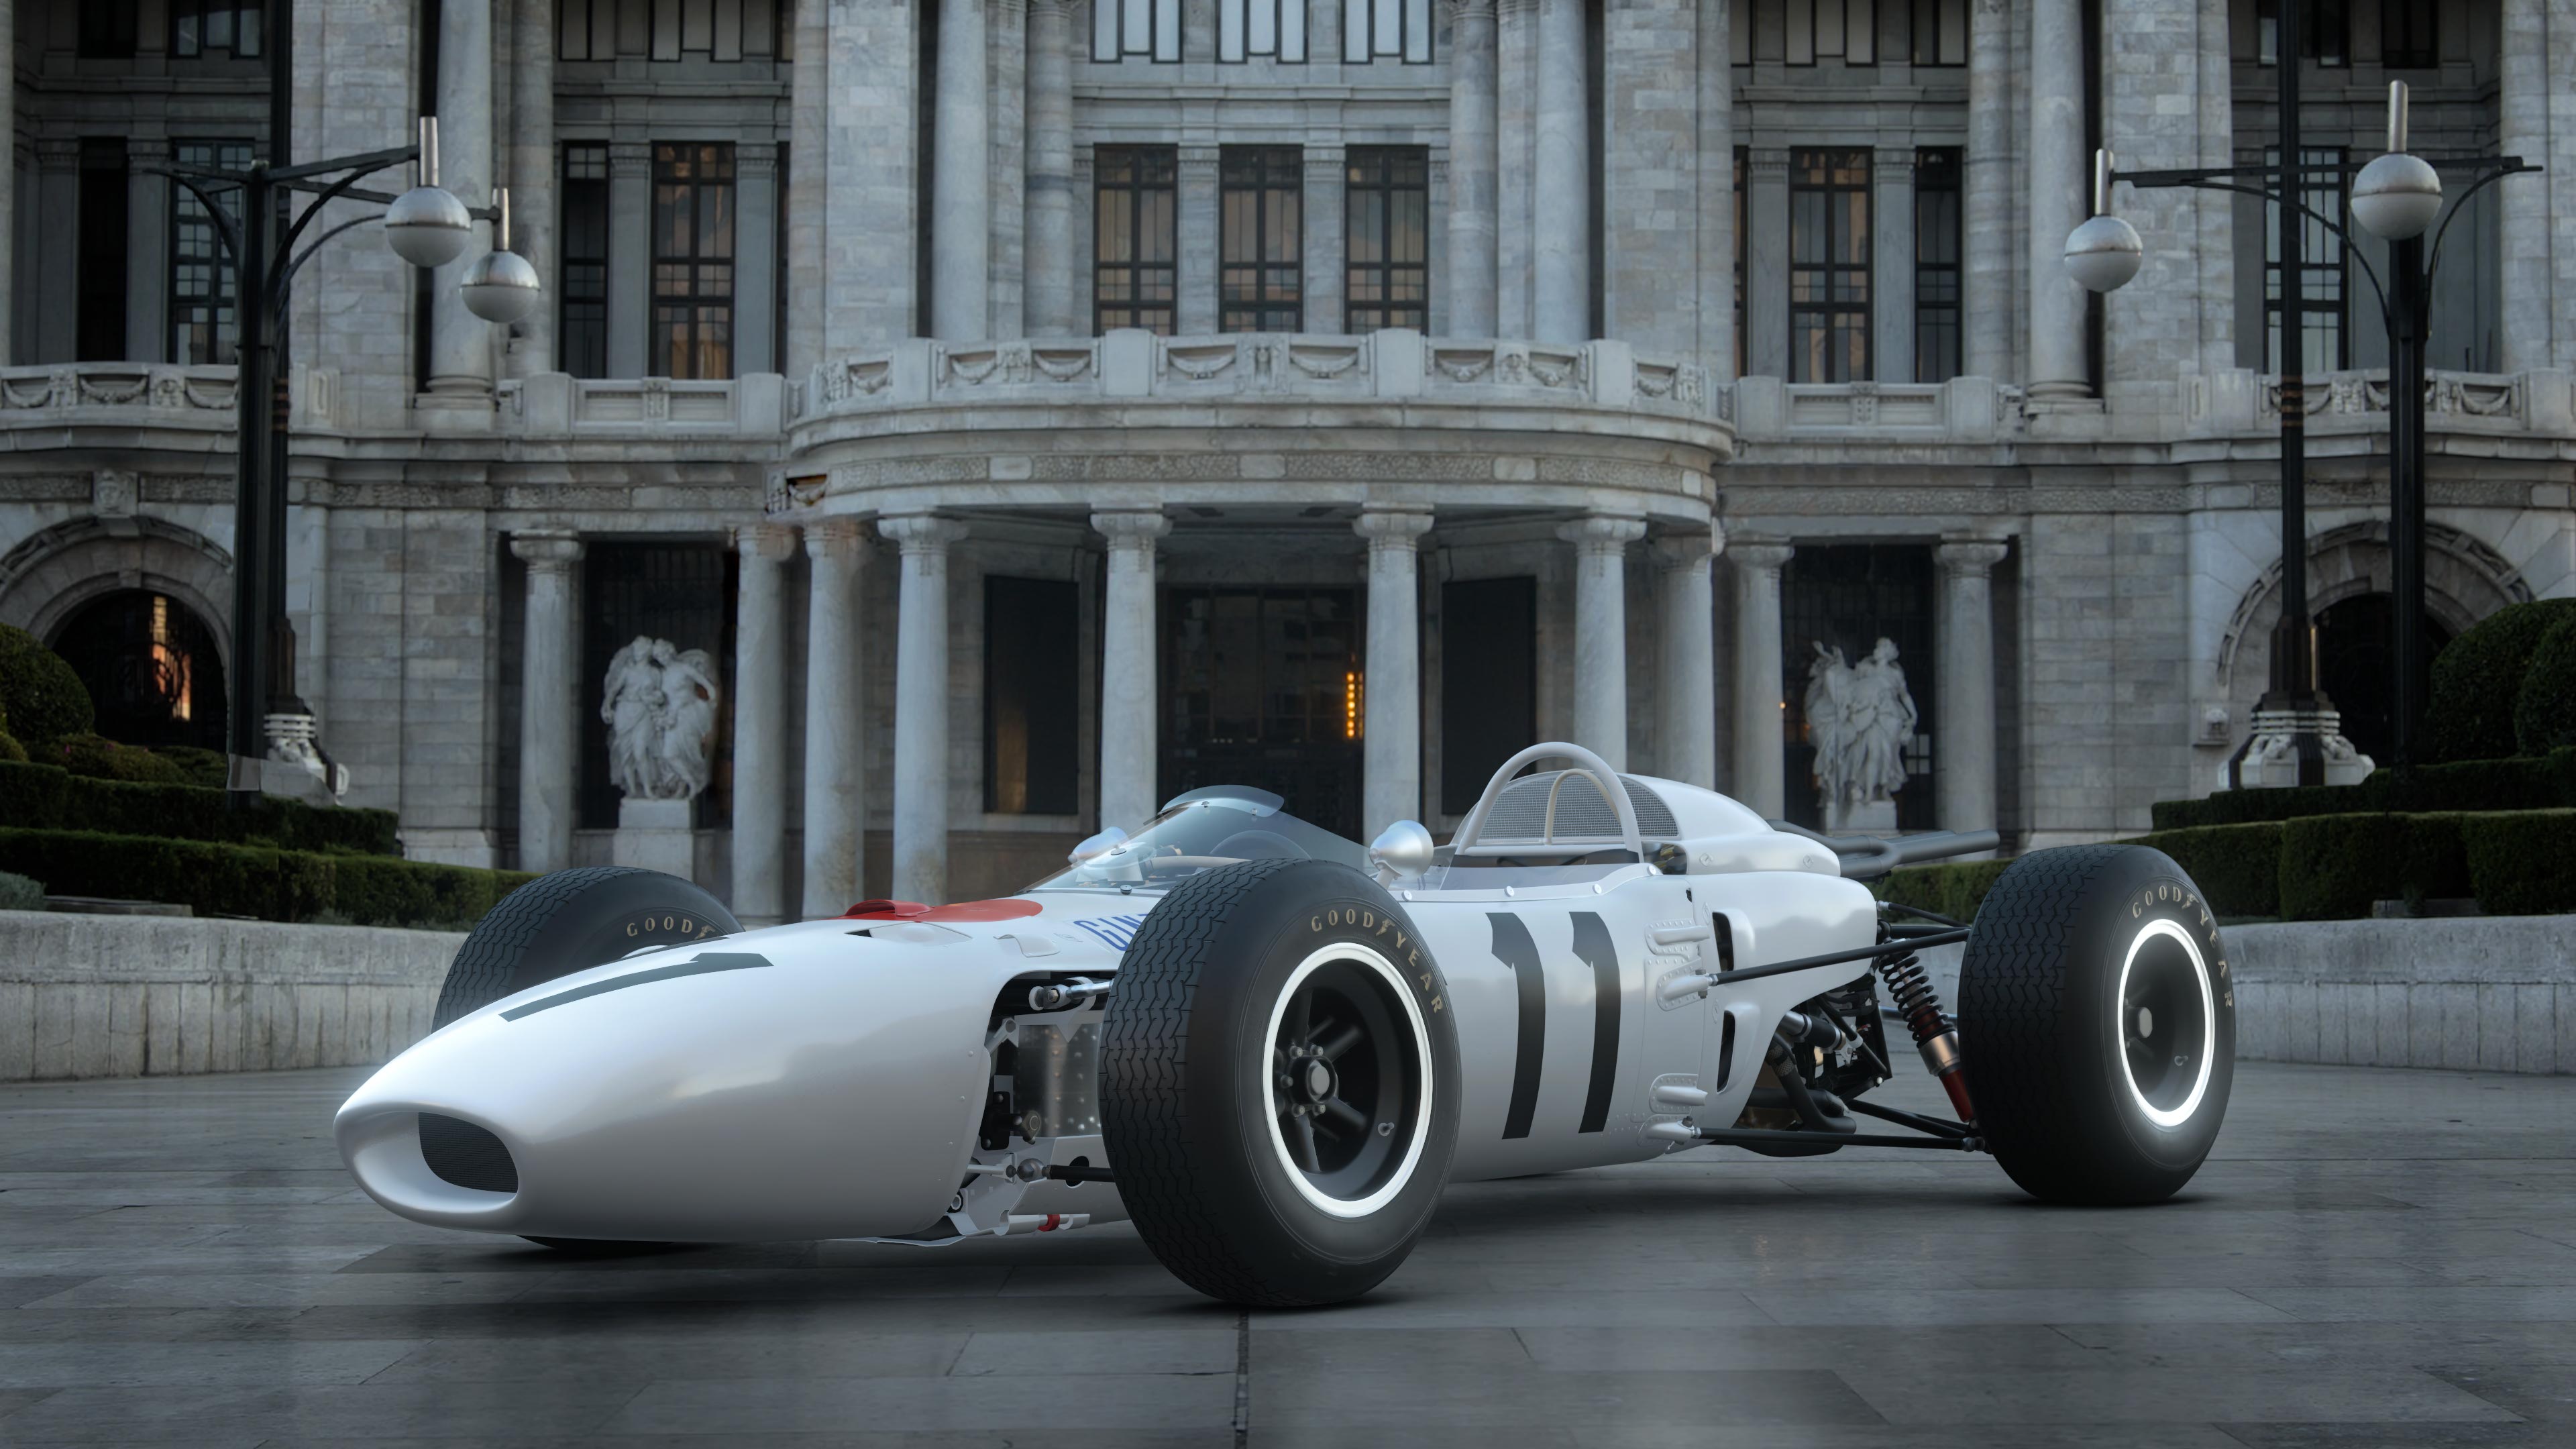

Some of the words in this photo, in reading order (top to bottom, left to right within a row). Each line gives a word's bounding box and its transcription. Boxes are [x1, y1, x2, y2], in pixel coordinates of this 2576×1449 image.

[627, 916, 718, 937] GOOD
[1311, 908, 1443, 1013] GOODYEAR
[2133, 885, 2233, 1008] GOODYEAR
[1485, 911, 1621, 1139] 11
